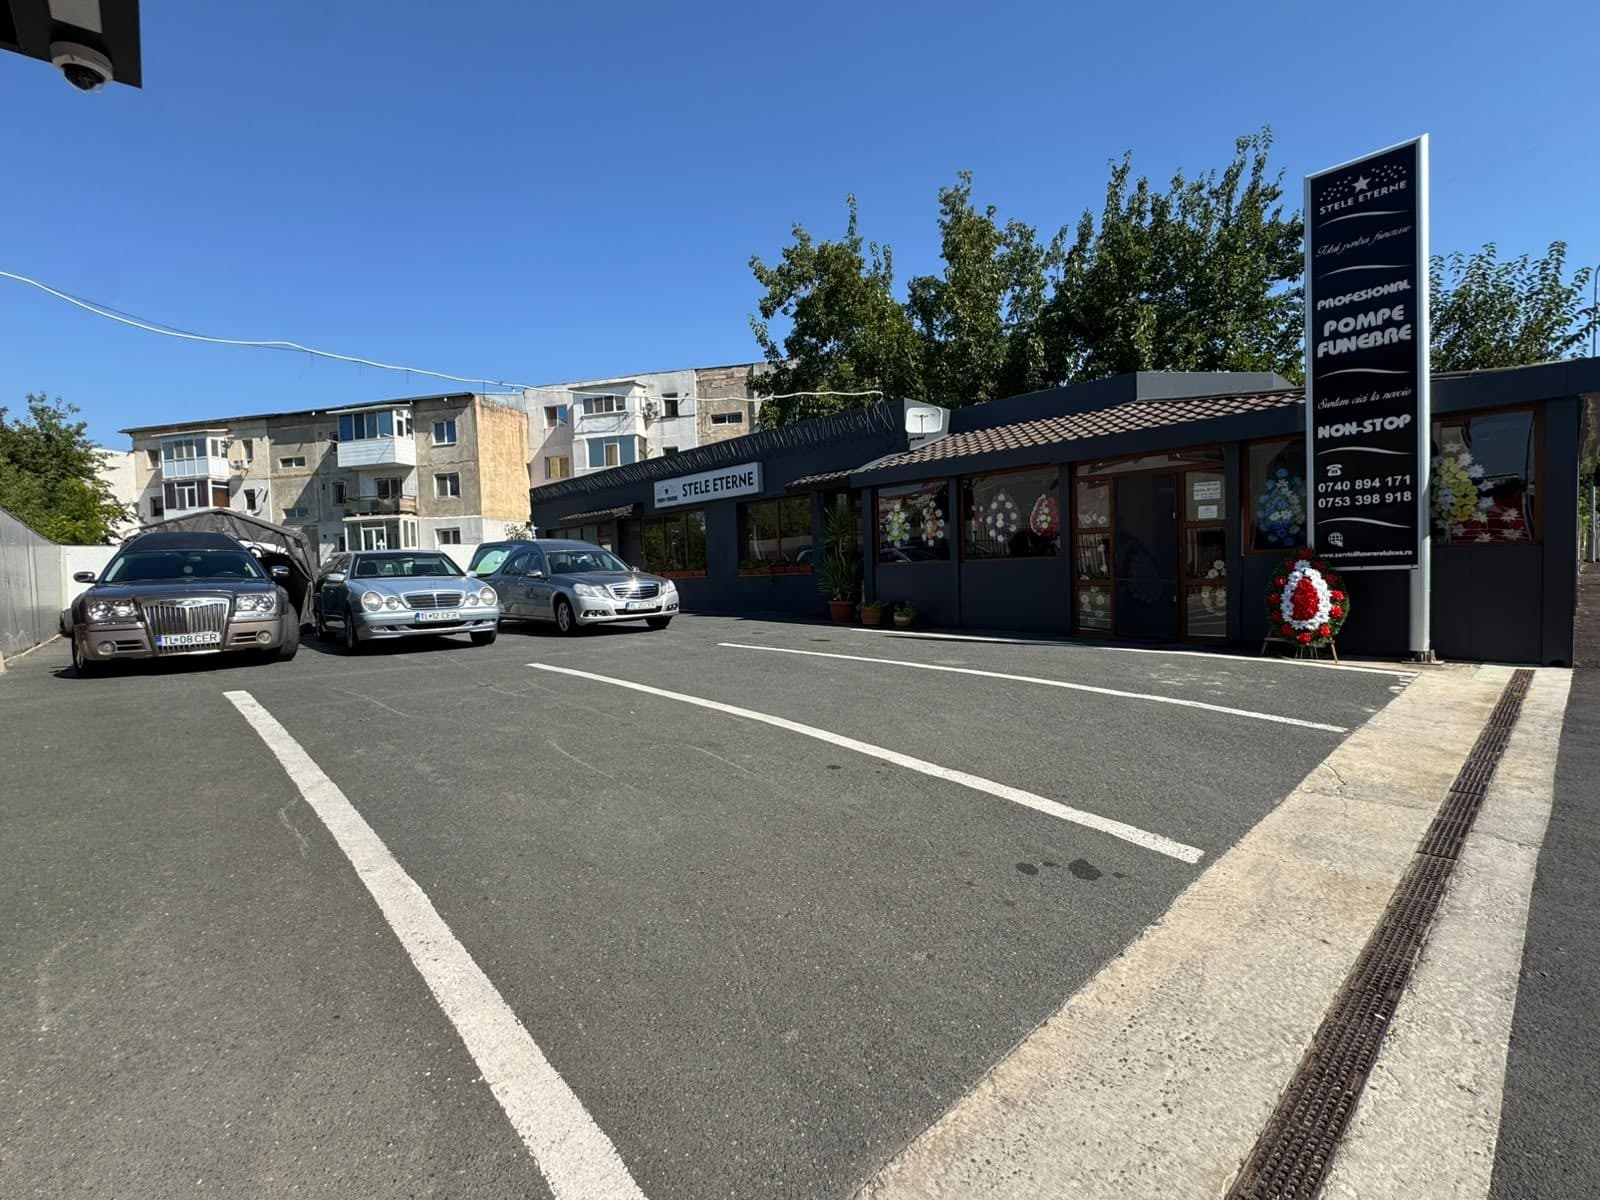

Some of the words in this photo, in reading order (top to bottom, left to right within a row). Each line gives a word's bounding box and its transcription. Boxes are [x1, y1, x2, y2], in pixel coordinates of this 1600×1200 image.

[1320, 197, 1354, 215] STELE
[1358, 180, 1408, 203] ETERNE
[1317, 279, 1411, 311] PROFESIONAL
[1323, 304, 1405, 337] POMPE
[1317, 324, 1412, 358] FUNEBRE
[1317, 413, 1411, 439] NON-STOP
[682, 479, 711, 497] STELE
[712, 471, 754, 492] ETERNE
[1318, 481, 1351, 493] 0740
[1355, 477, 1381, 490] 894
[1385, 474, 1411, 487] 171
[1318, 496, 1351, 508] 0753
[1355, 493, 1381, 506] 398
[1385, 490, 1412, 503] 918
[163, 636, 176, 645] TL
[180, 635, 193, 644] 08
[194, 633, 217, 643] CER
